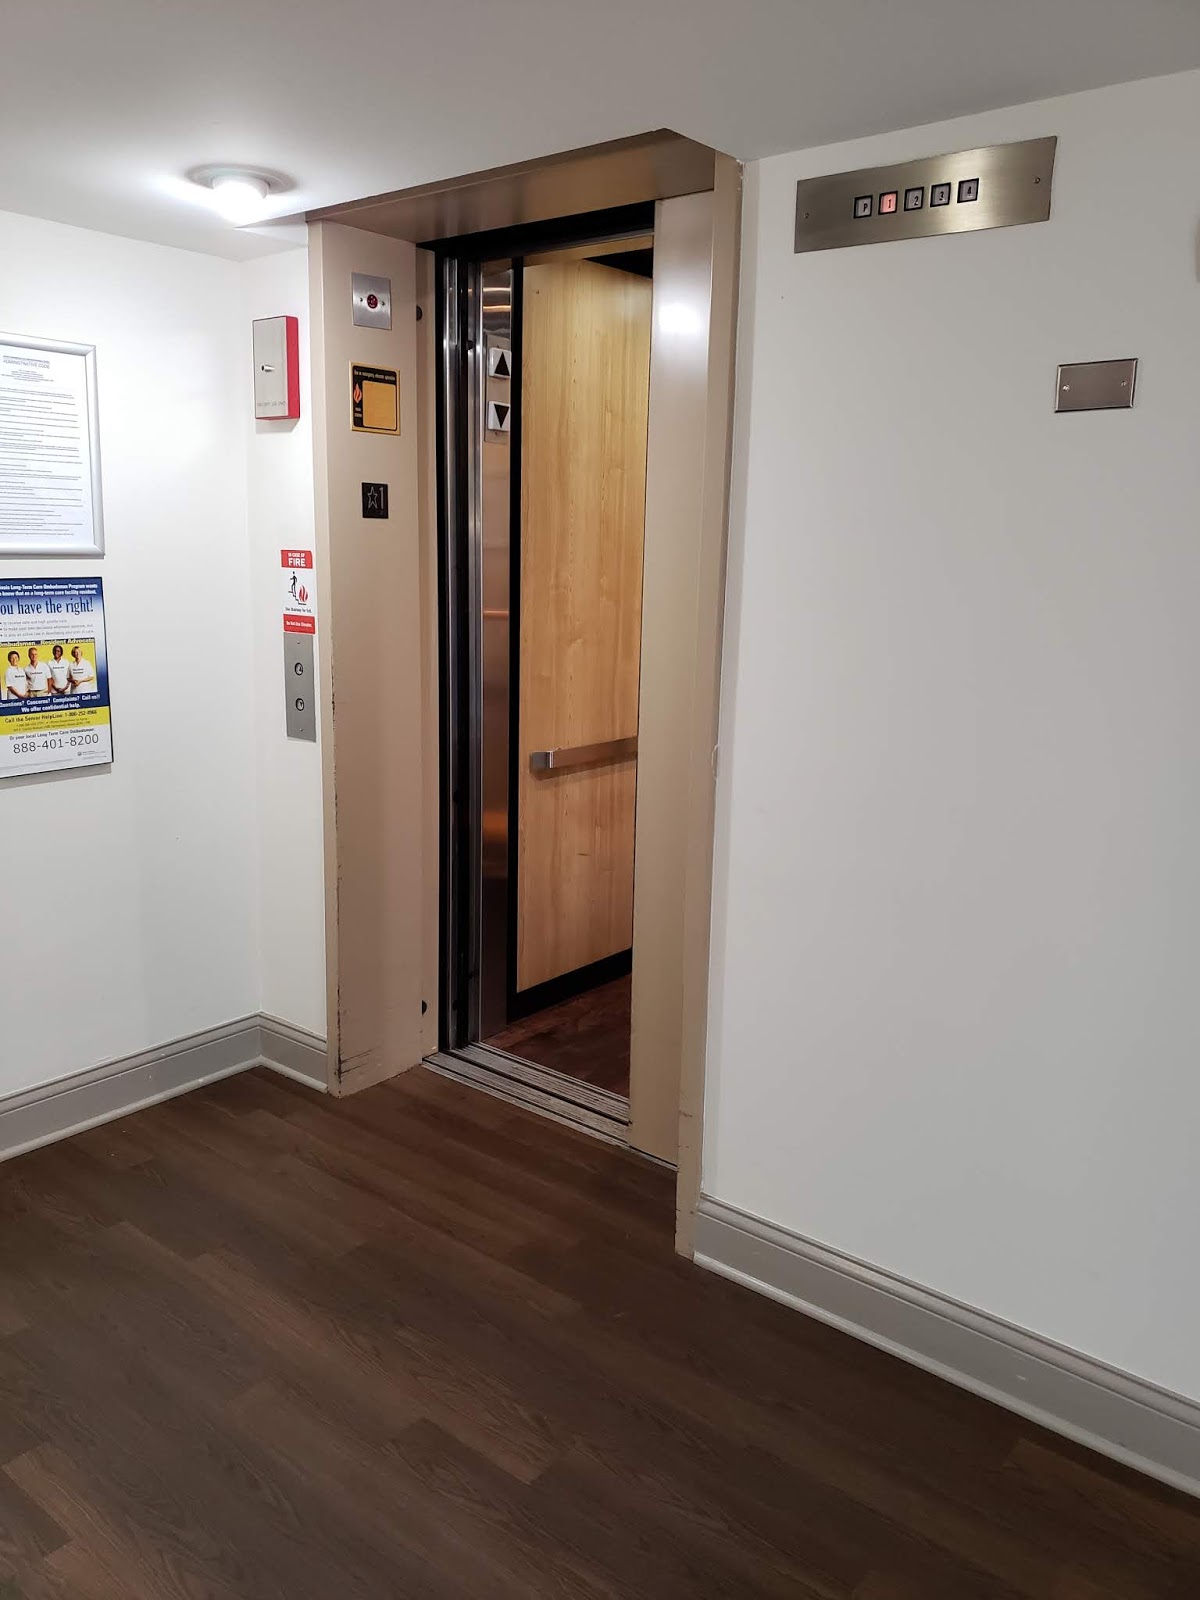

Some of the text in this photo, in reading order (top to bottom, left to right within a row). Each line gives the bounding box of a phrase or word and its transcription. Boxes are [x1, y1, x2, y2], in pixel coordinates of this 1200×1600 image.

[863, 203, 868, 212] P
[914, 196, 919, 206] 2
[939, 191, 944, 201] 3
[379, 486, 384, 510] 1
[288, 558, 306, 566] FIRE
[0, 597, 94, 615] ou have the right!
[26, 698, 50, 706] Concerns?
[13, 733, 99, 754] 888-401-8200
